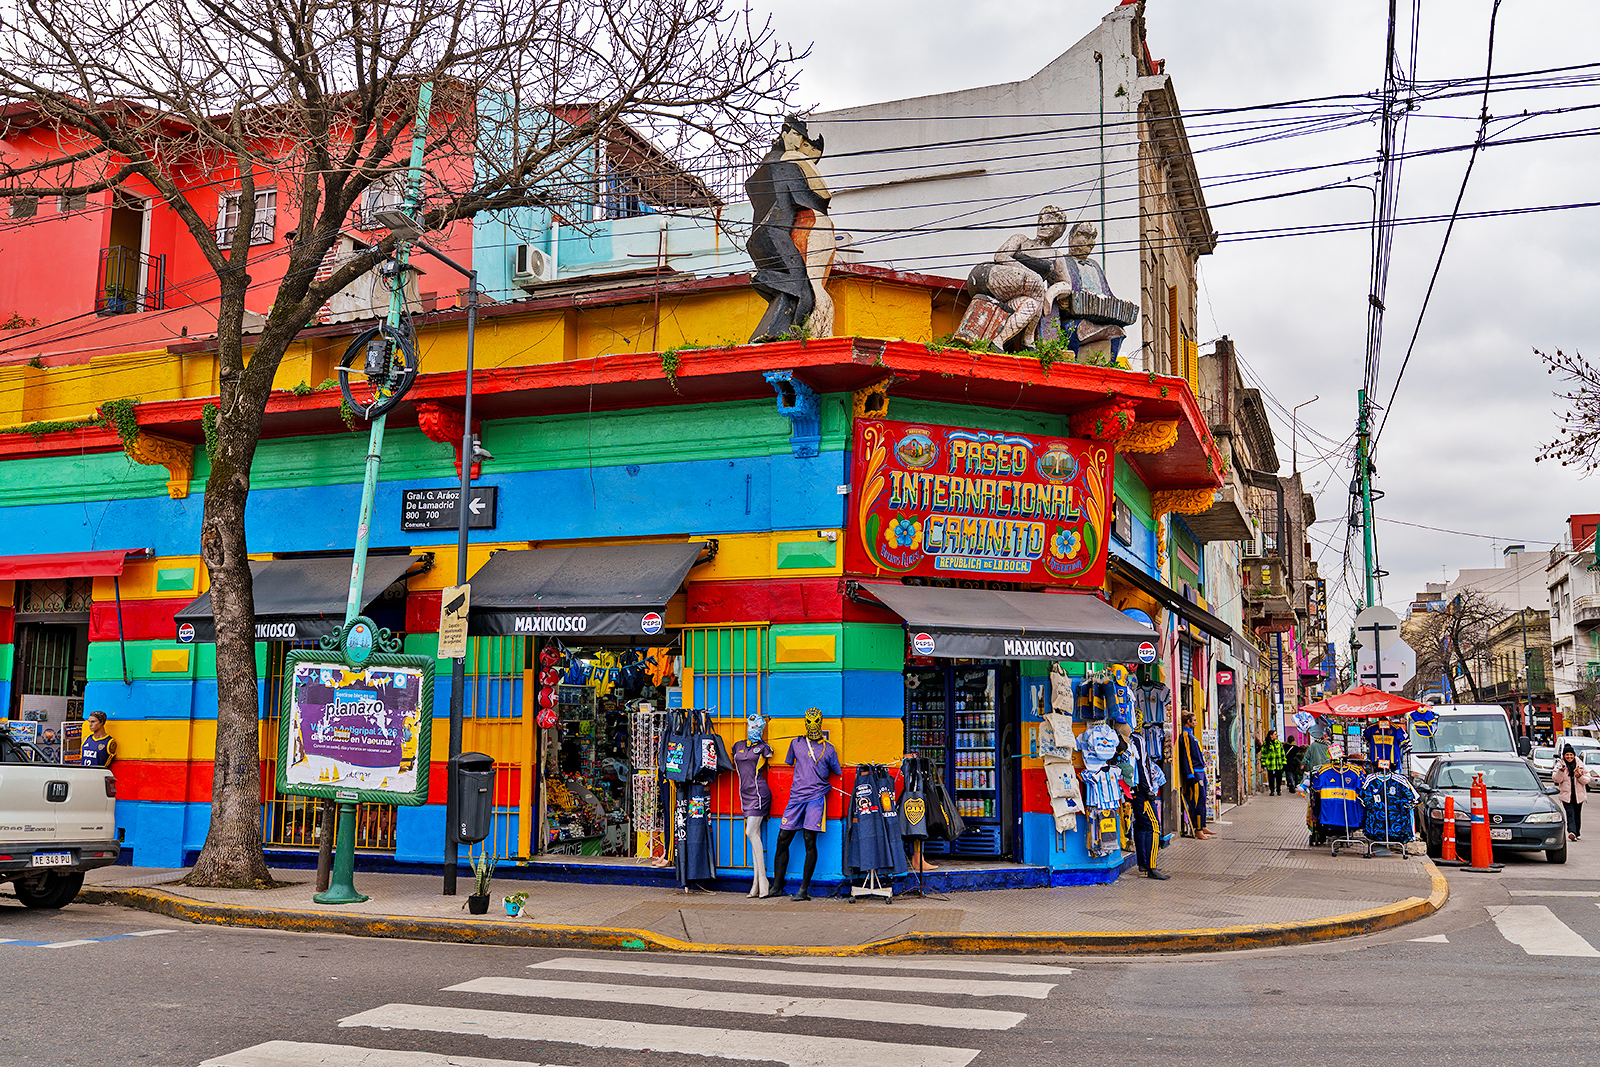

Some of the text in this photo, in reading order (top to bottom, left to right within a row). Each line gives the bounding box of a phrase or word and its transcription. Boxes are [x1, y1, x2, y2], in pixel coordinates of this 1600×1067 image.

[950, 440, 1027, 476] PASEO
[407, 491, 459, 500] Gral. G. Aráoz
[889, 470, 1080, 522] INTERNACIONAL
[418, 501, 454, 509] Lamadrid
[406, 511, 439, 519] 800 700
[924, 515, 1045, 558] CAMINITO
[939, 559, 981, 570] REPUBLICA
[514, 616, 587, 632] MAXIKIOSCO
[1003, 639, 1075, 657] MAXIKIOSCO
[326, 698, 383, 721] planazo
[1335, 700, 1390, 712] Coca-Cola
[377, 727, 397, 737] 226
[83, 750, 97, 758] BOCA
[1373, 794, 1381, 803] 10
[46, 856, 59, 864] 348
